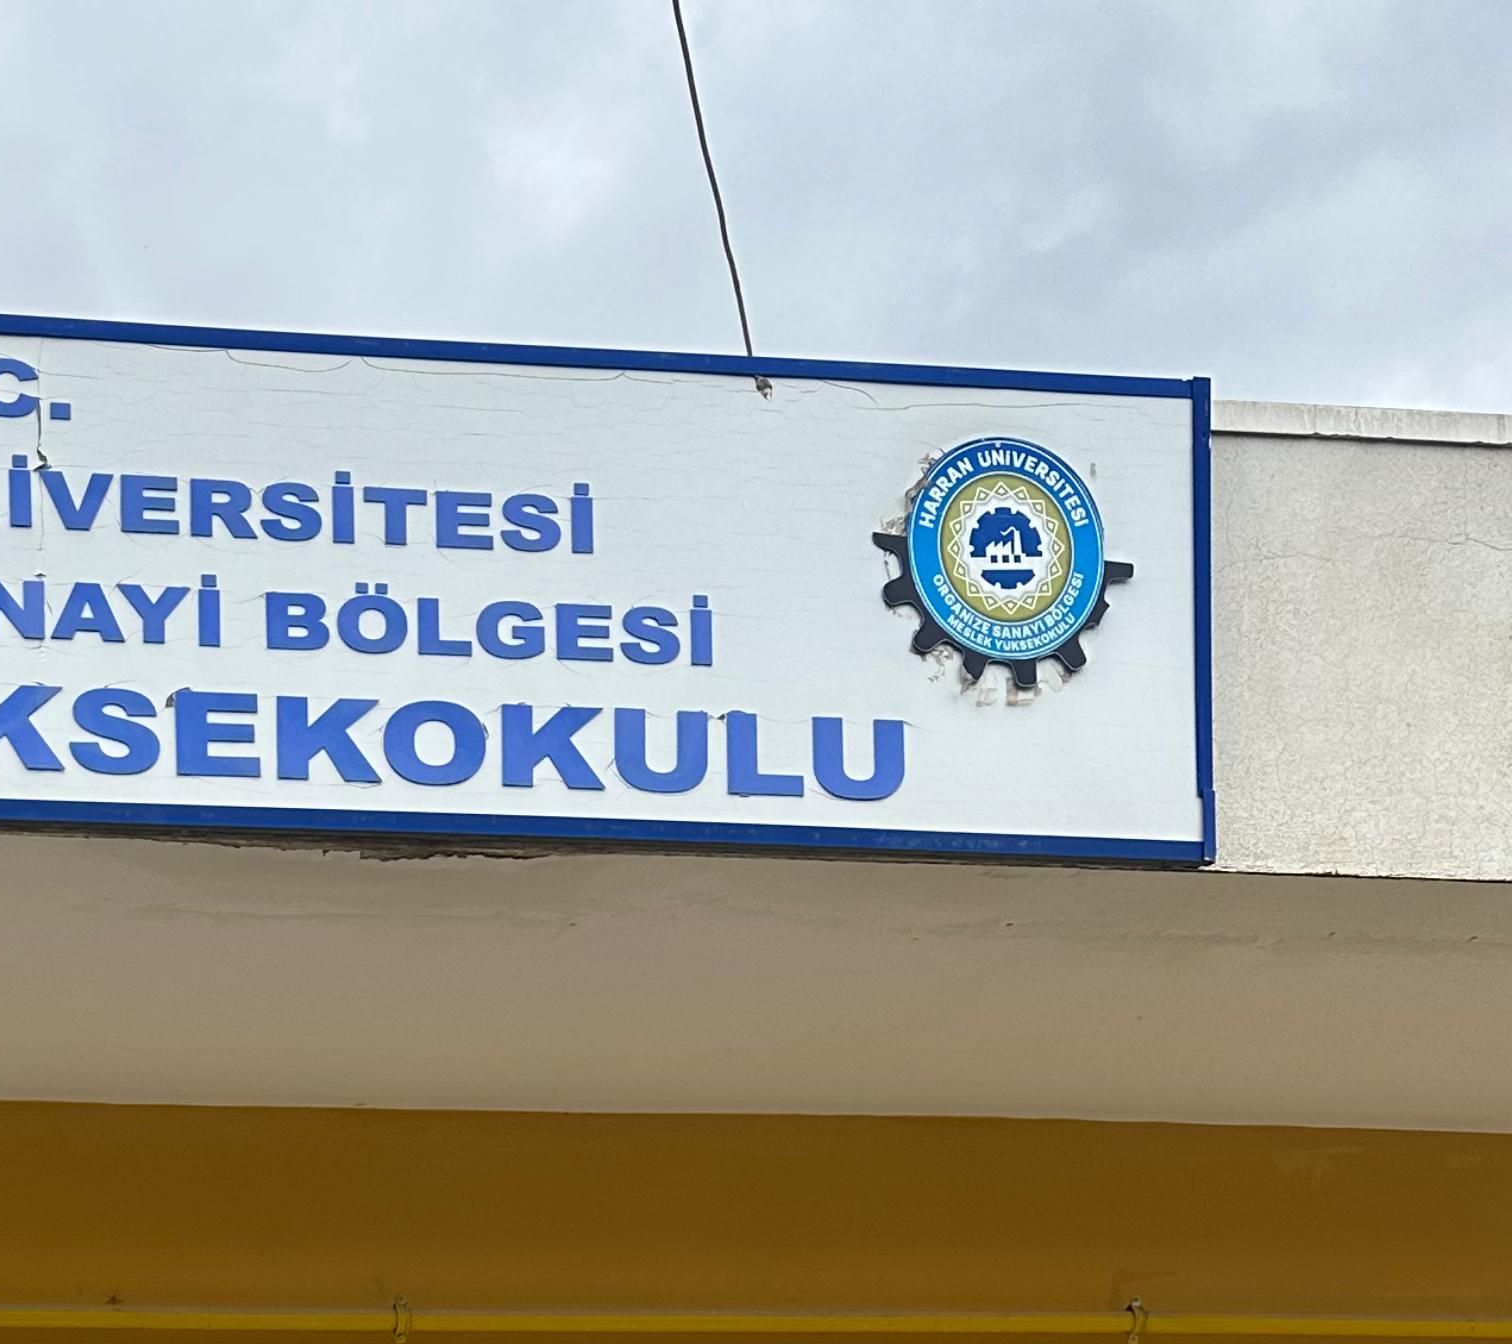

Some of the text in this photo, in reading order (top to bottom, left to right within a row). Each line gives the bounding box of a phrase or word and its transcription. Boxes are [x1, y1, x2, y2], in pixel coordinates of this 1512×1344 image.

[919, 457, 974, 528] HARRAN
[264, 582, 713, 666] BÖLGESİ
[947, 614, 993, 648] MESLEK
